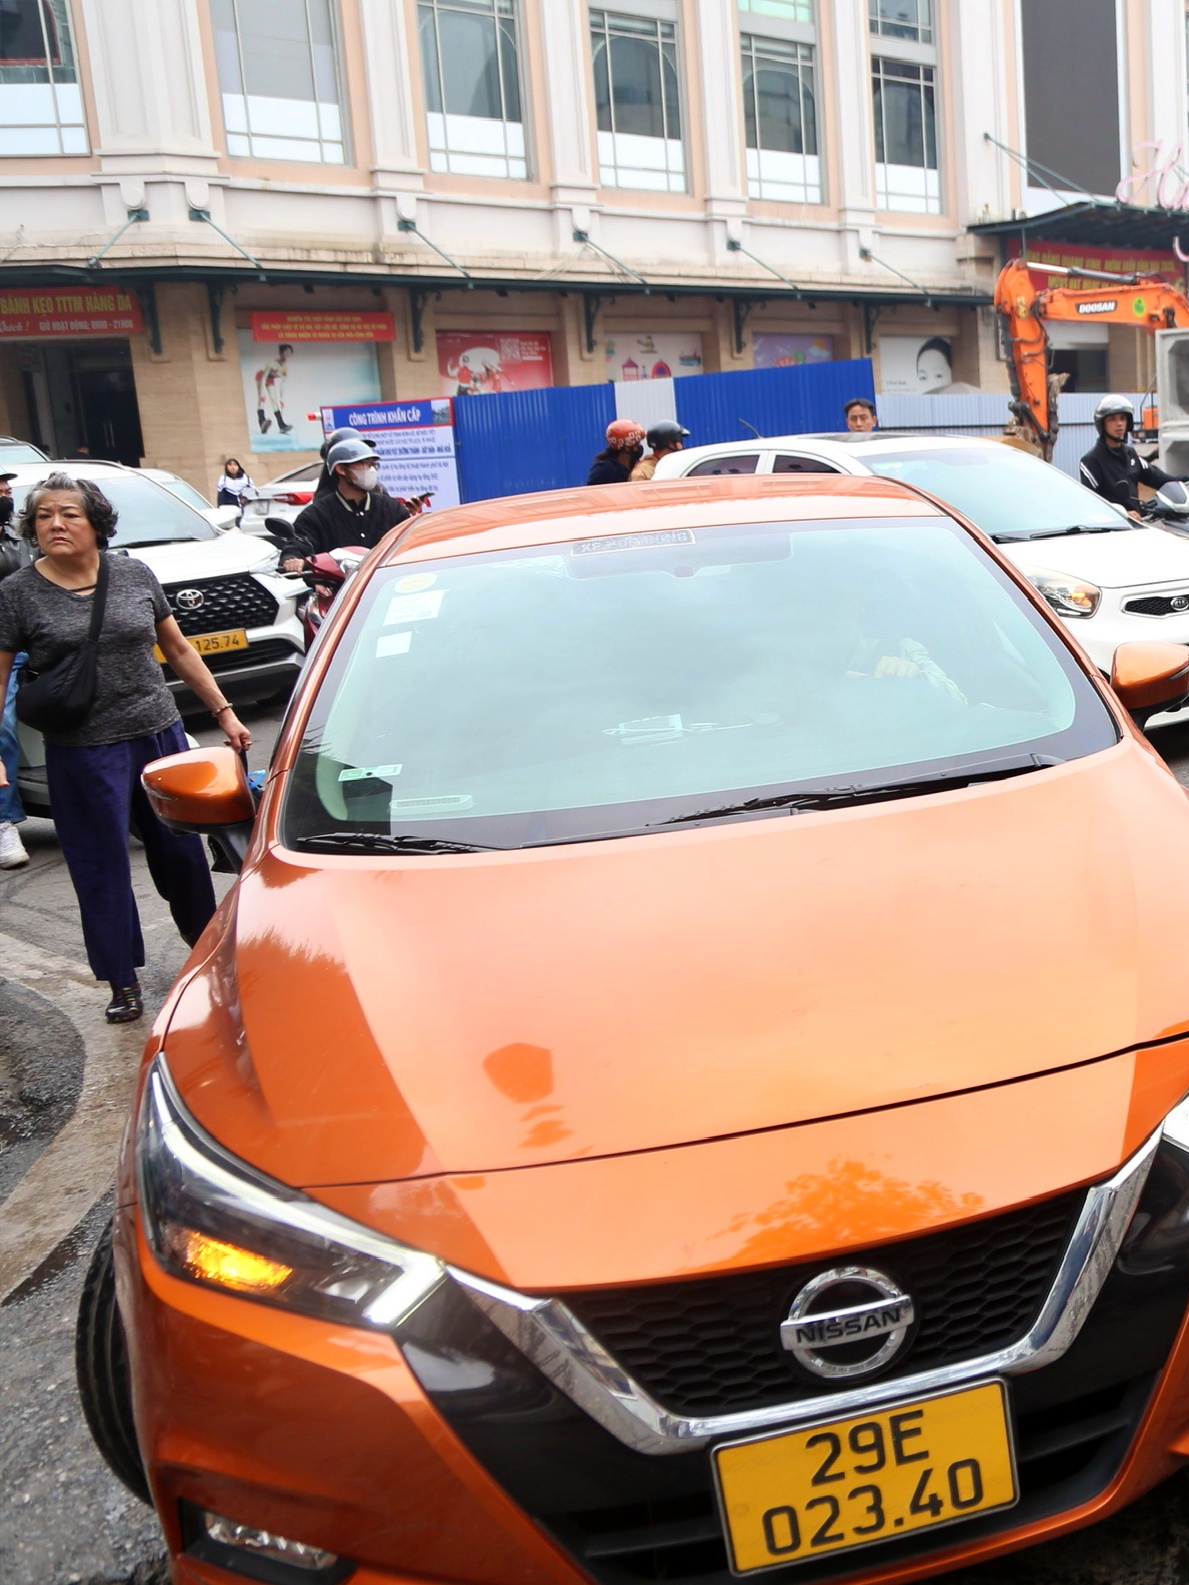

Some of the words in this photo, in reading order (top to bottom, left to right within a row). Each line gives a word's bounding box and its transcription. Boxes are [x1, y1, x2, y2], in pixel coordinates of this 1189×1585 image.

[86, 292, 115, 312] HÀNG
[1079, 301, 1115, 313] DOOSAN
[349, 411, 367, 426] CÔNG
[366, 409, 387, 425] TRÌNH
[387, 406, 406, 424] KHẨN
[407, 405, 421, 422] CẤP
[796, 1308, 901, 1345] NISSAN
[805, 1409, 929, 1487] 29E
[762, 1458, 983, 1555] 023.40
